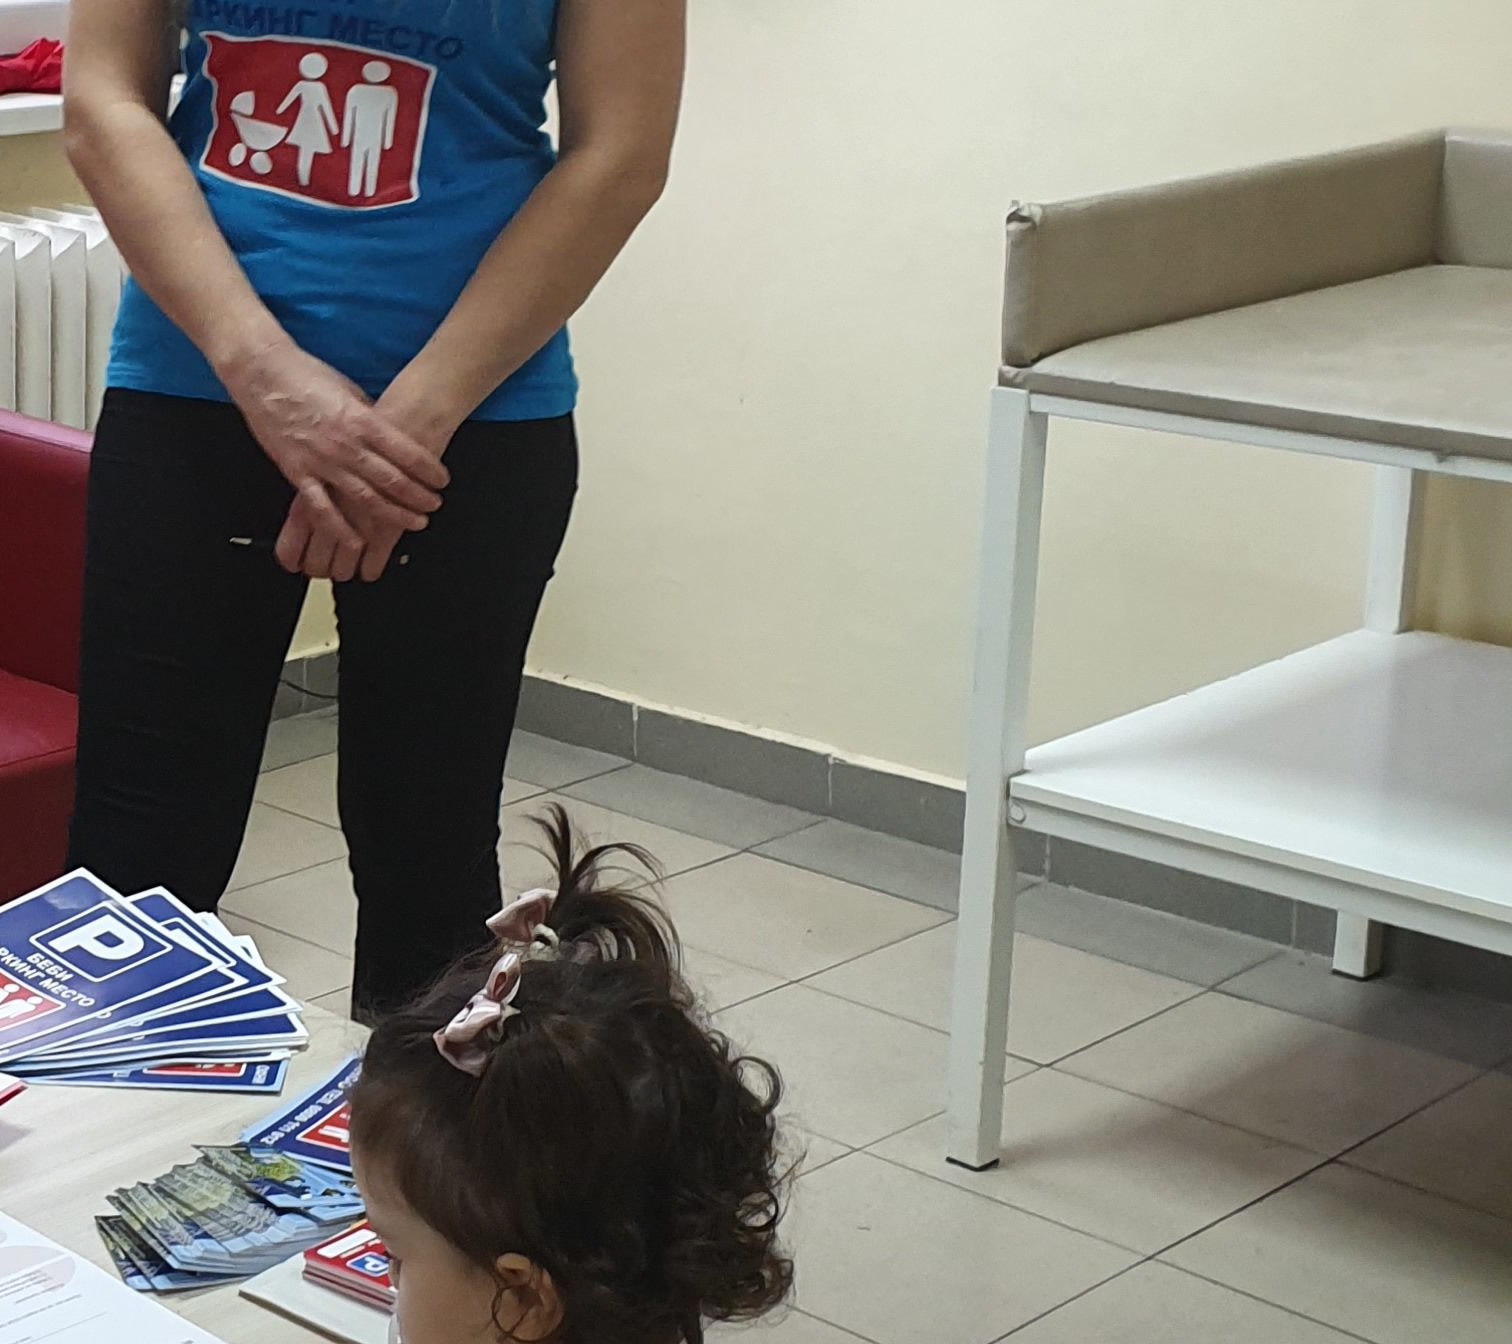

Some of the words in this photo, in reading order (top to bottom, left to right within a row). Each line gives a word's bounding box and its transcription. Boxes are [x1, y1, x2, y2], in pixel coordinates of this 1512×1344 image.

[329, 12, 465, 60] МЕСТО
[48, 914, 145, 961] P
[26, 952, 74, 982] БЕБИ
[39, 976, 95, 1007] МЕСТО
